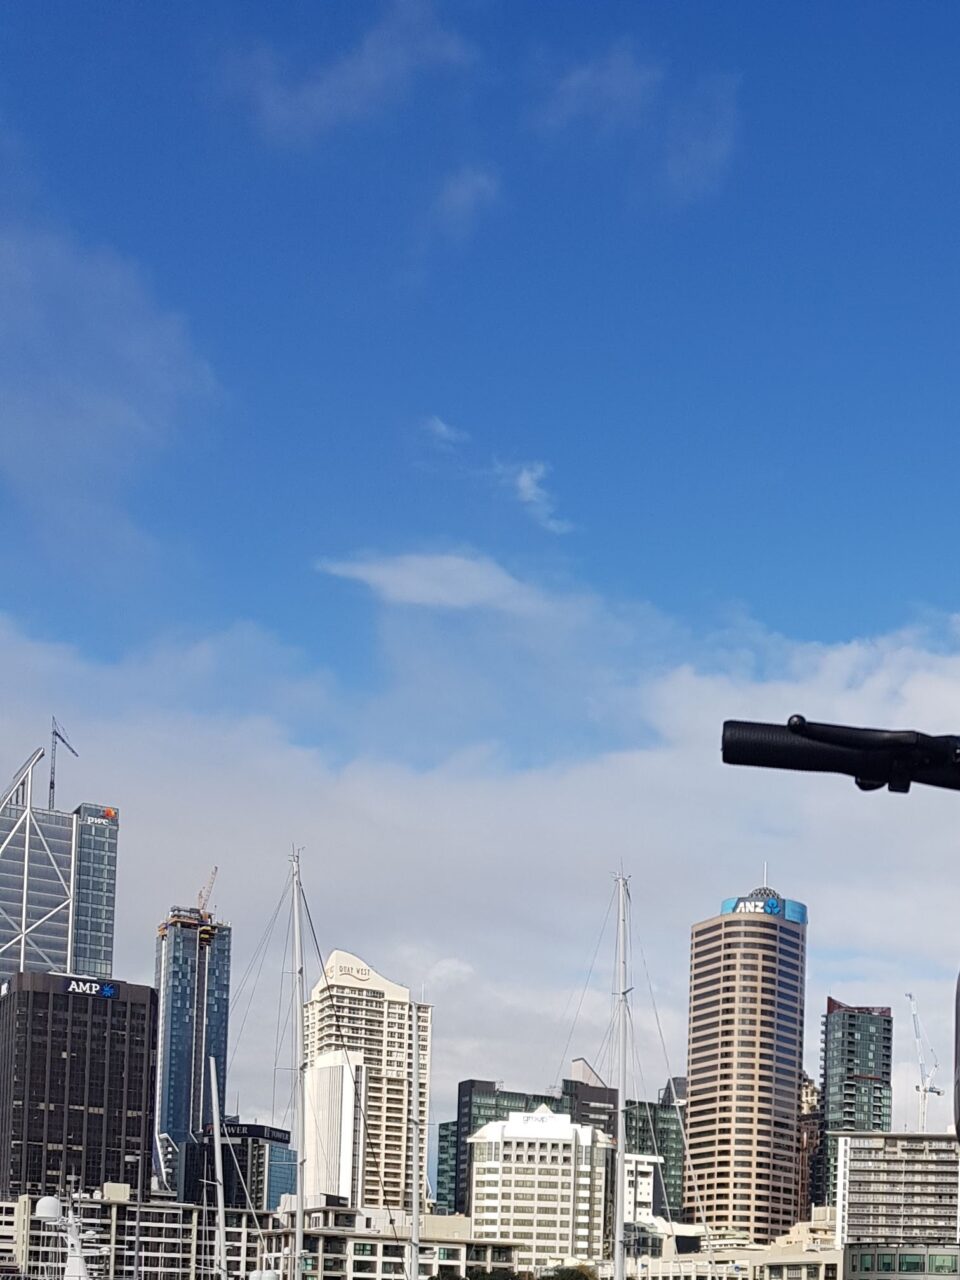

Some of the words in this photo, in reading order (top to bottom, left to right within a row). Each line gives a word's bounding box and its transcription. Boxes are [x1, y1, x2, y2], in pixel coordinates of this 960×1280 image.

[736, 901, 765, 913] ANZ
[339, 965, 354, 974] QUAY
[356, 967, 370, 976] WEST
[68, 980, 100, 994] AMP
[220, 1126, 248, 1134] OWER
